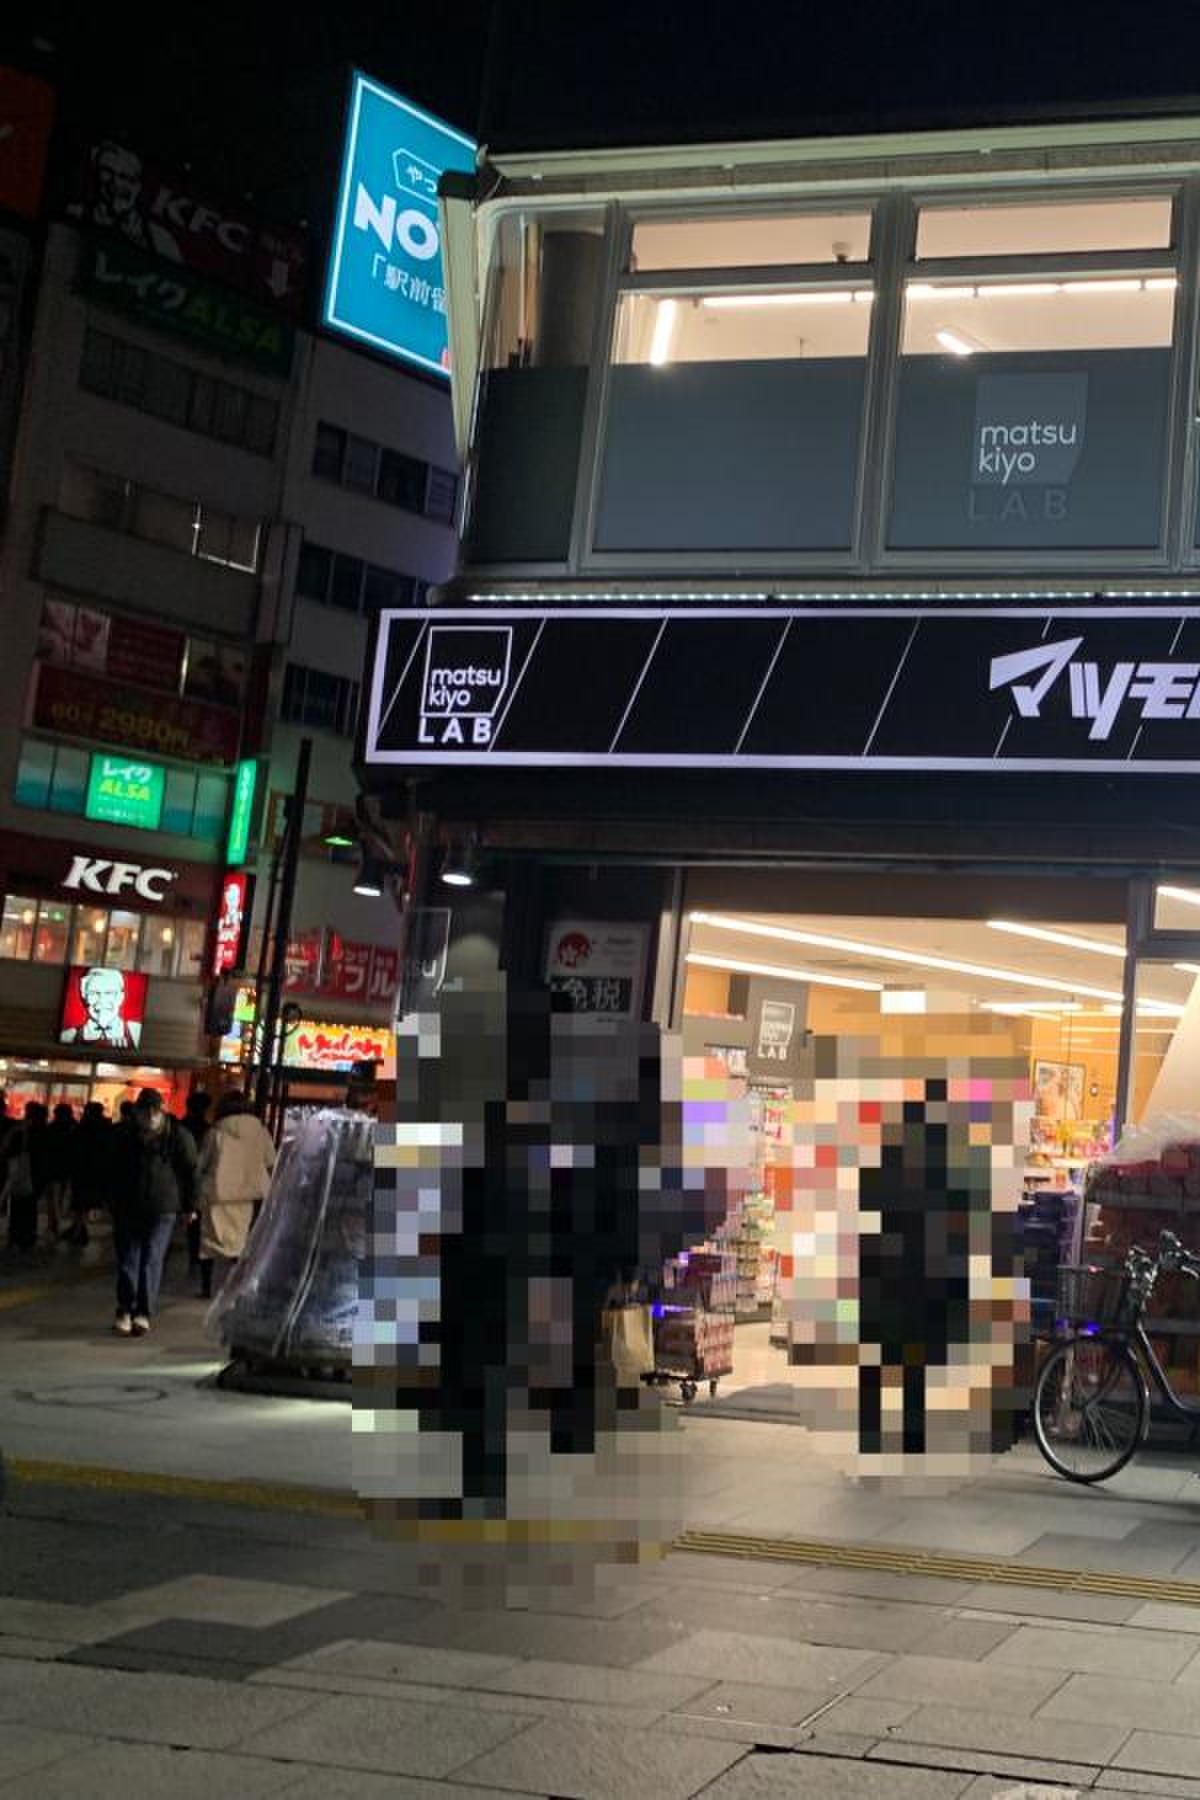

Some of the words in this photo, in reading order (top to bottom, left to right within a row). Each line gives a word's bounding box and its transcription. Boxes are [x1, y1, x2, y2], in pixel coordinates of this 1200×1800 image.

[151, 184, 252, 255] KFC
[353, 181, 440, 261] NO
[980, 421, 1077, 446] matsu
[978, 447, 1036, 485] kiyo
[431, 665, 501, 686] matsu
[429, 685, 471, 715] kiyo
[418, 717, 492, 743] LAB
[64, 856, 173, 901] KFC
